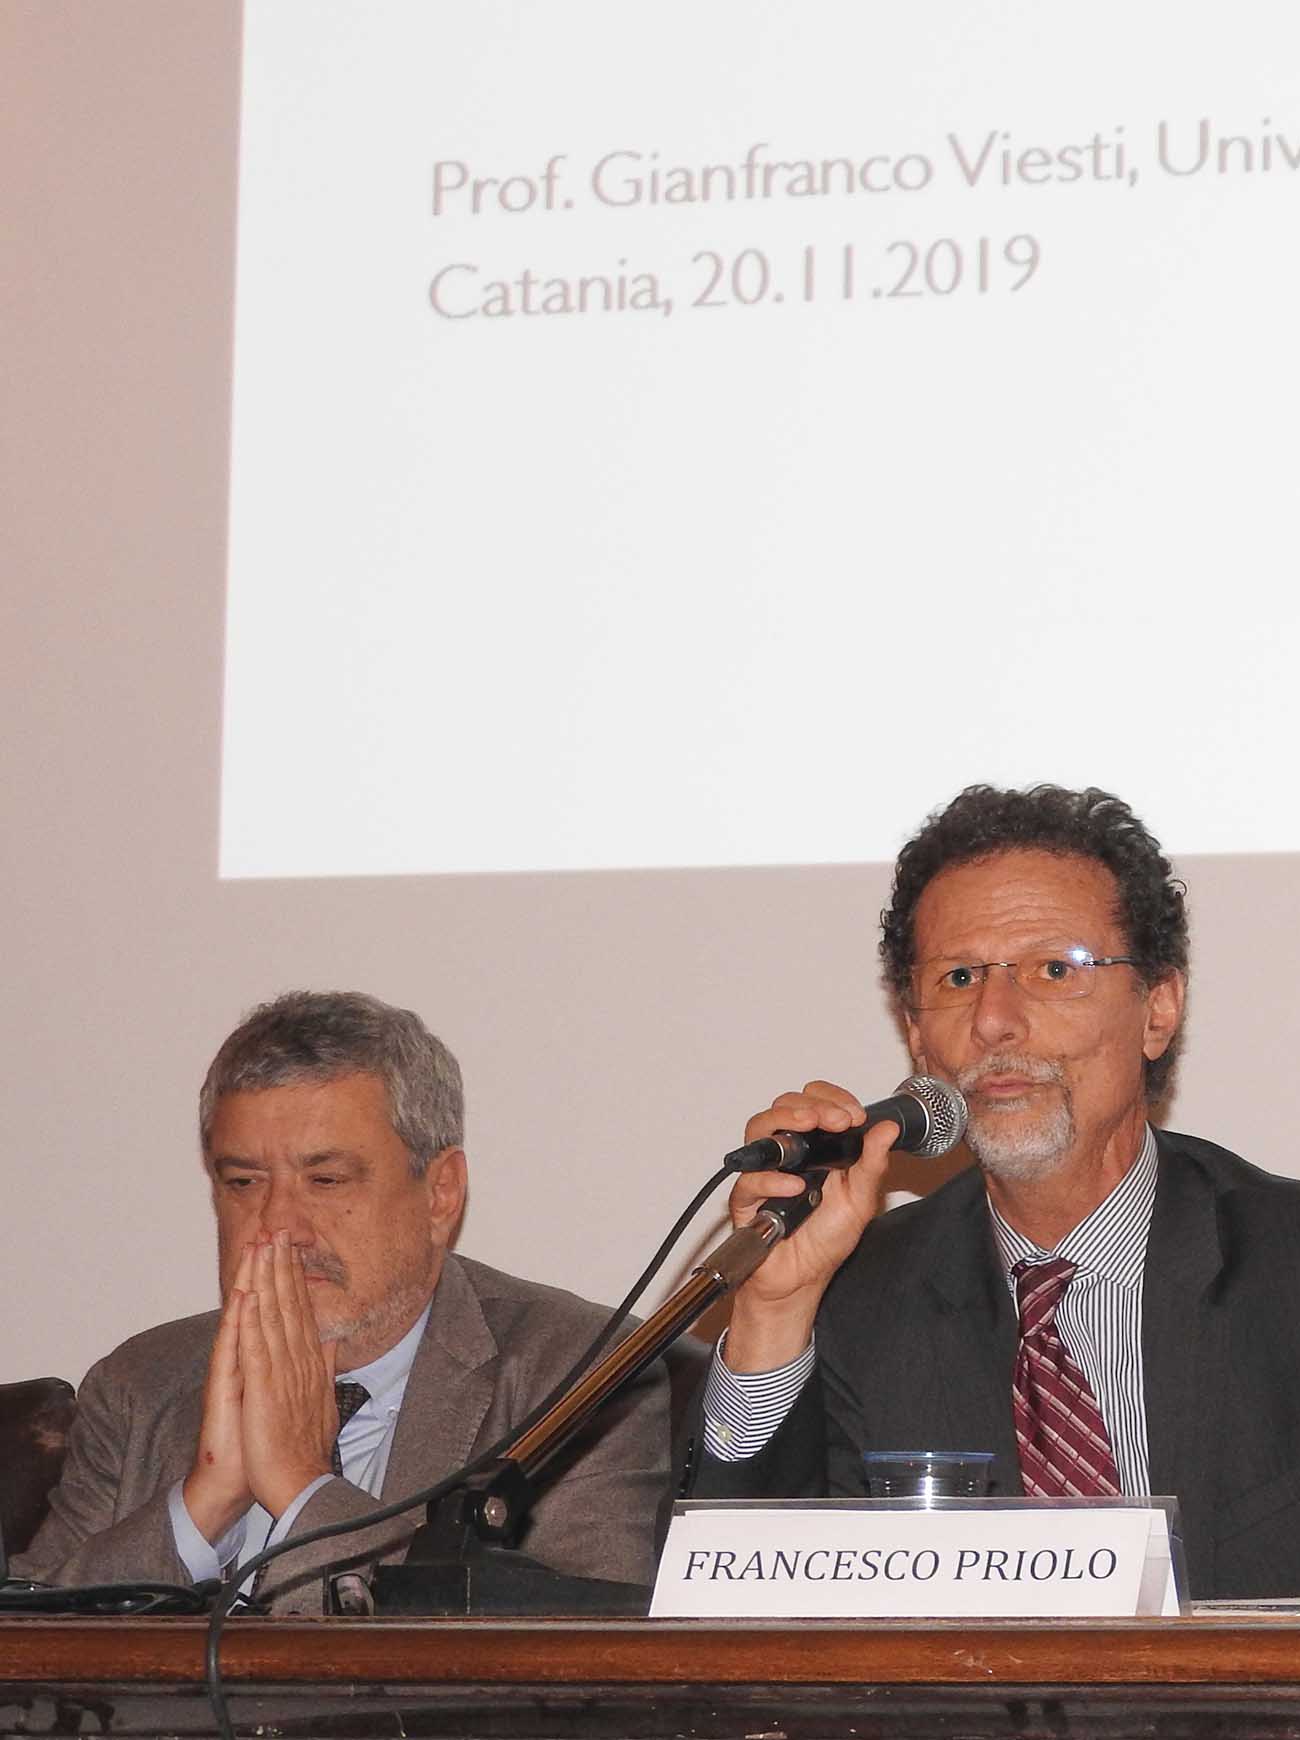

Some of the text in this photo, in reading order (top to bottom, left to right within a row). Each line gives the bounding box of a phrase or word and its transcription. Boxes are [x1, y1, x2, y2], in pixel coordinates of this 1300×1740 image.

[431, 154, 575, 217] Prof.
[590, 142, 934, 208] Gianfranco
[946, 126, 1139, 188] Viesti,
[427, 233, 1041, 320] Catania, 20.11.2019
[682, 1548, 1117, 1581] FRANCESCO PRIOLO
